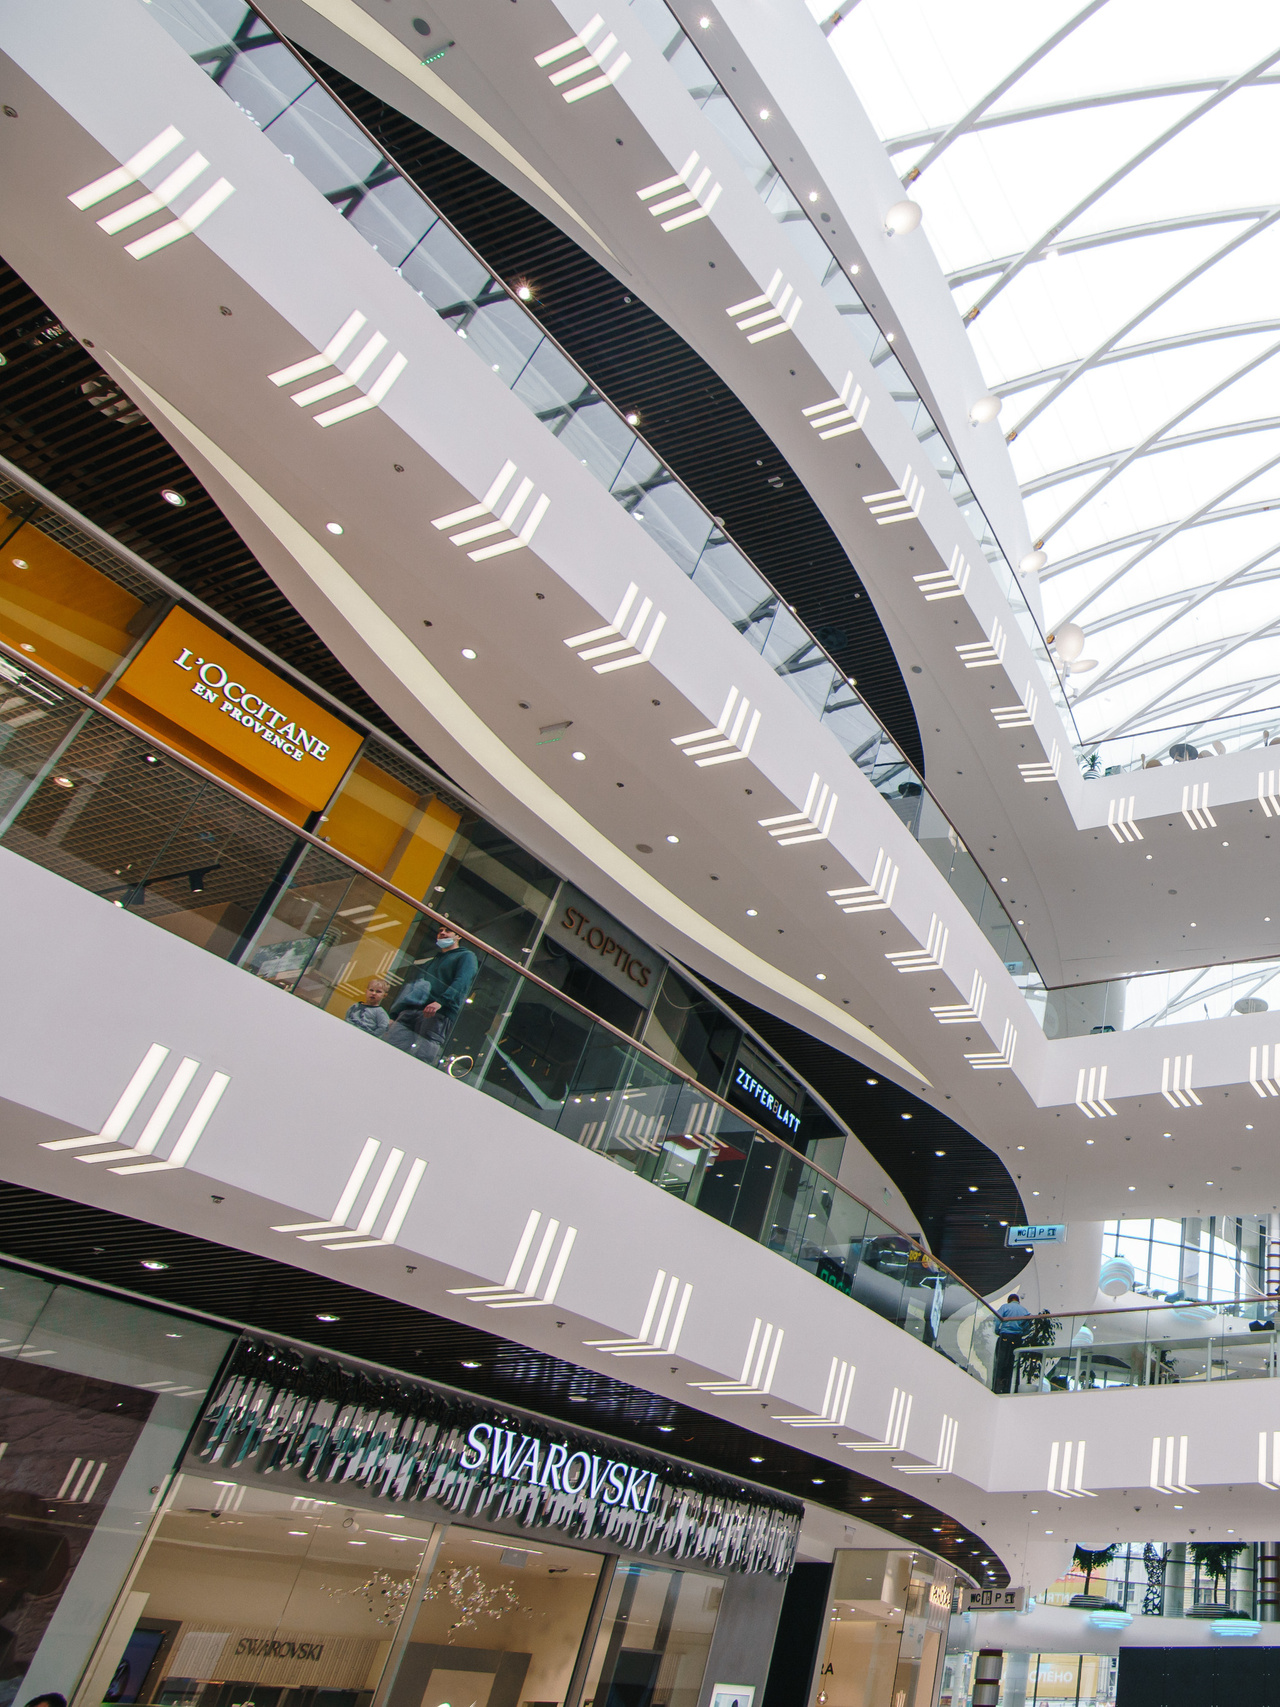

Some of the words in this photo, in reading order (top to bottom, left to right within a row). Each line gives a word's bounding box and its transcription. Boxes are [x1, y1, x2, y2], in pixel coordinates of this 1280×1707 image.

[173, 648, 330, 762] L'OCCITANE
[191, 682, 219, 703] EN
[220, 701, 304, 762] PROVENCE
[561, 906, 651, 988] ST.OPTICS
[736, 1068, 801, 1132] ZIFFERBLATT
[460, 1423, 659, 1513] SWAROVSKI
[970, 1593, 981, 1603] WC
[995, 1593, 1002, 1602] P
[235, 1638, 324, 1661] SWAROVSKI
